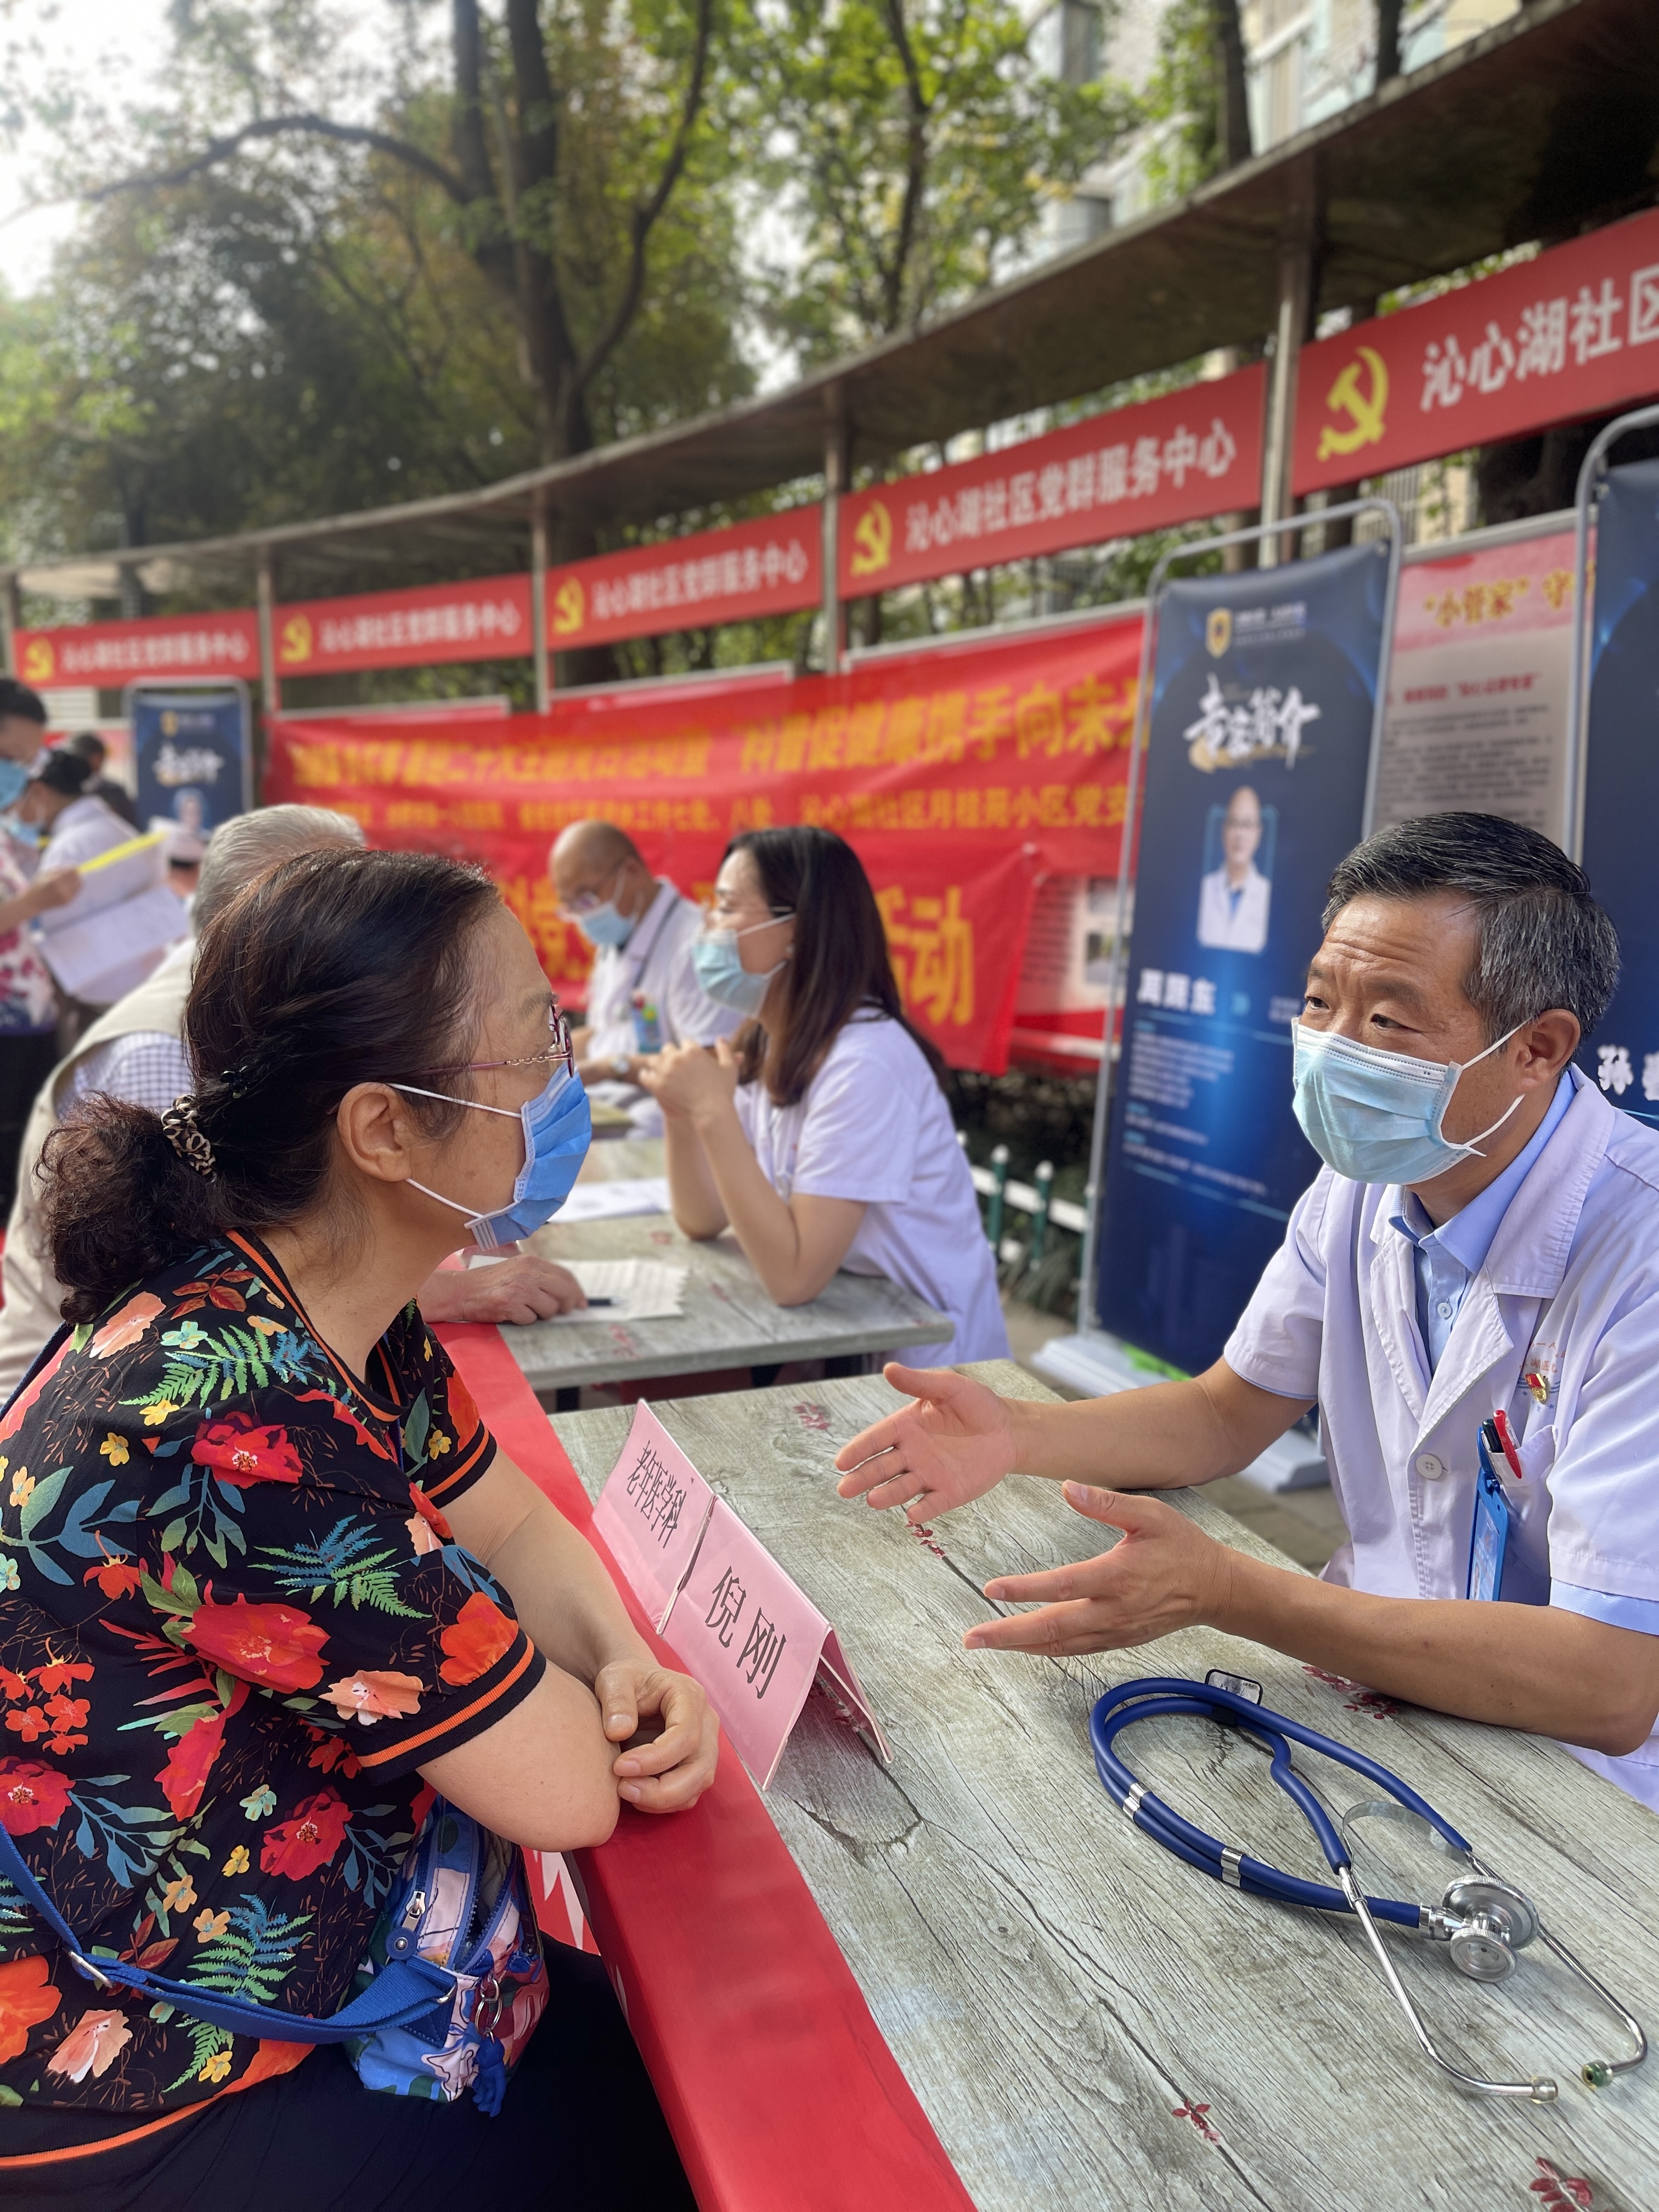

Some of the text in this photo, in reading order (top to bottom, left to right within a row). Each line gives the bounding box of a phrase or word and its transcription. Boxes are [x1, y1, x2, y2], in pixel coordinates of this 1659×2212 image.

[1420, 263, 1659, 413] 沁心湖社区
[905, 417, 1236, 552] 沁心湖社区党群服务中心
[627, 1440, 687, 1549] 老年医学科
[705, 1566, 786, 1700] 倪刚
